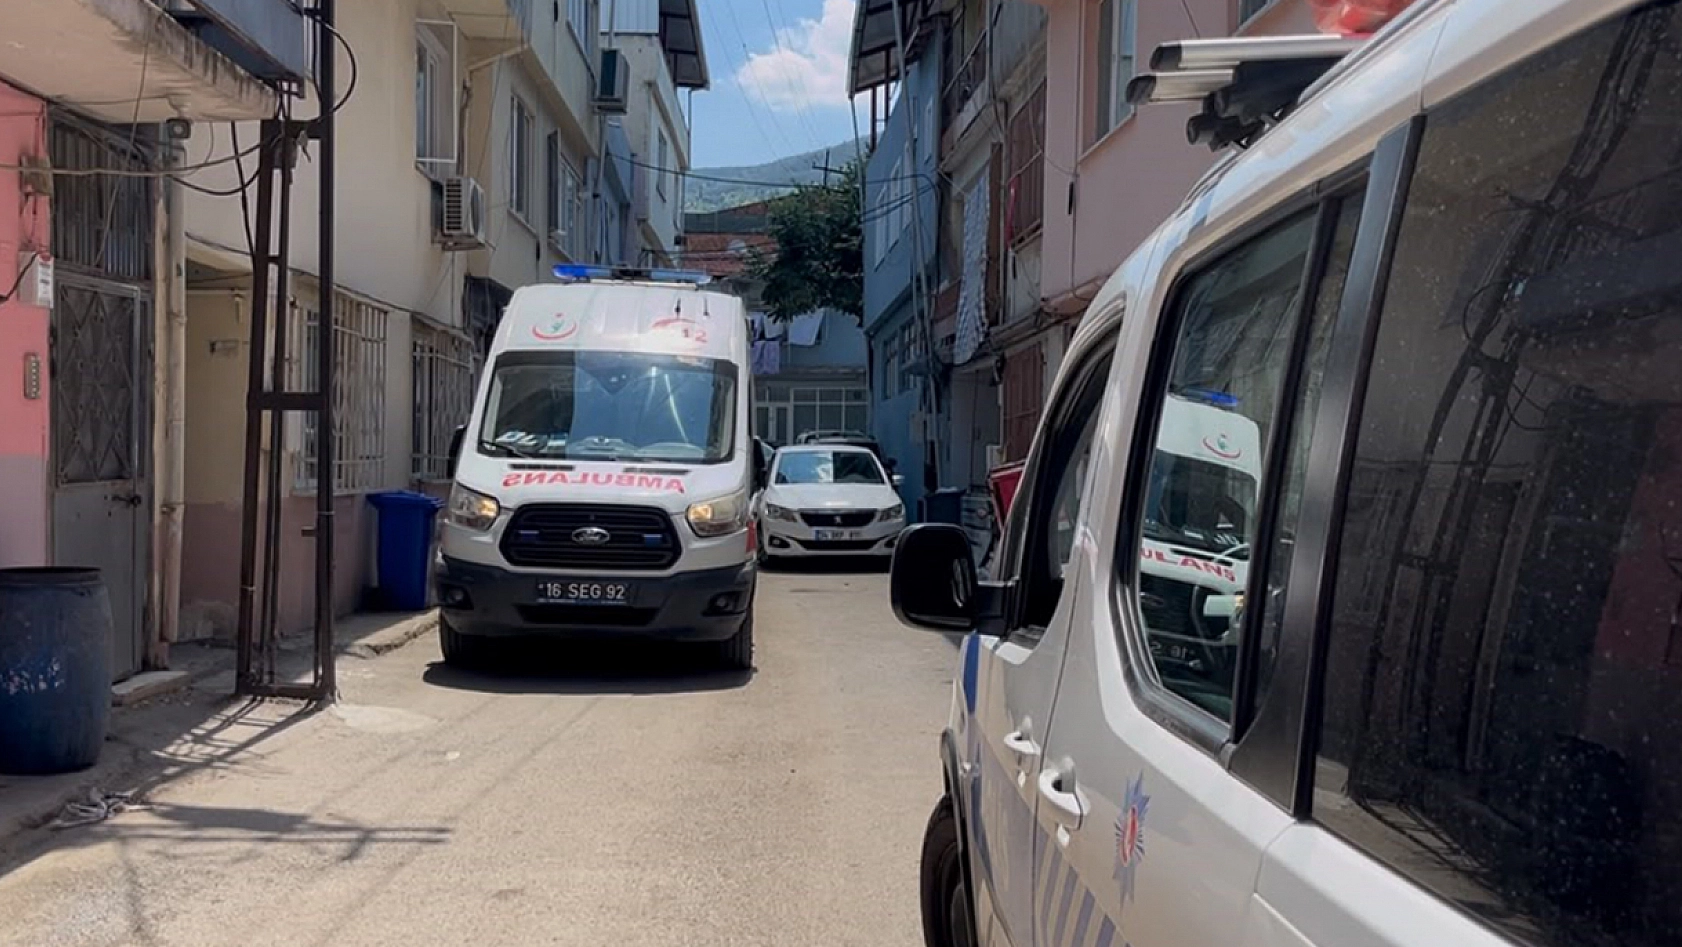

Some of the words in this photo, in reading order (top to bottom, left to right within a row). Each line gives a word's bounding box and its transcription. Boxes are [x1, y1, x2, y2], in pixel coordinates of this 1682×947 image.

[546, 582, 563, 598] 16
[568, 583, 602, 599] SEG
[606, 584, 626, 600] 92
